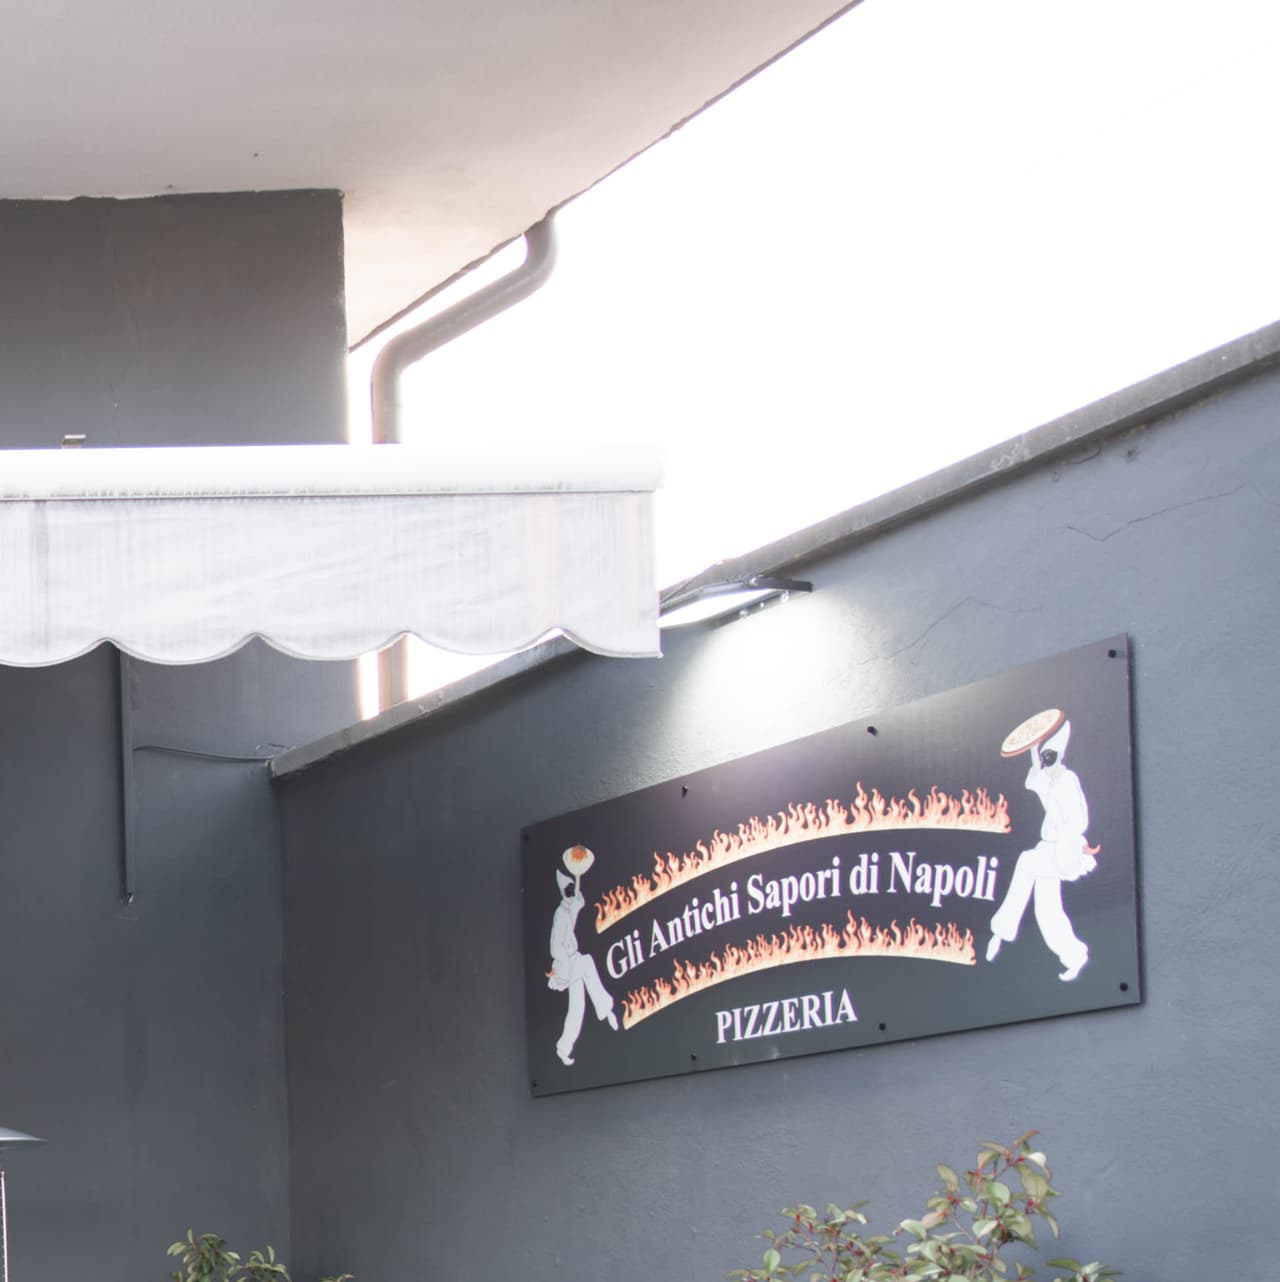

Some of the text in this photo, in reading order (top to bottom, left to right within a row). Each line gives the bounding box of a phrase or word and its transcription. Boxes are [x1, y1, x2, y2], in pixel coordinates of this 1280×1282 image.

[605, 851, 1000, 980] Gli Antichi Sapori di Napoli
[714, 987, 859, 1045] PIZZERIA
